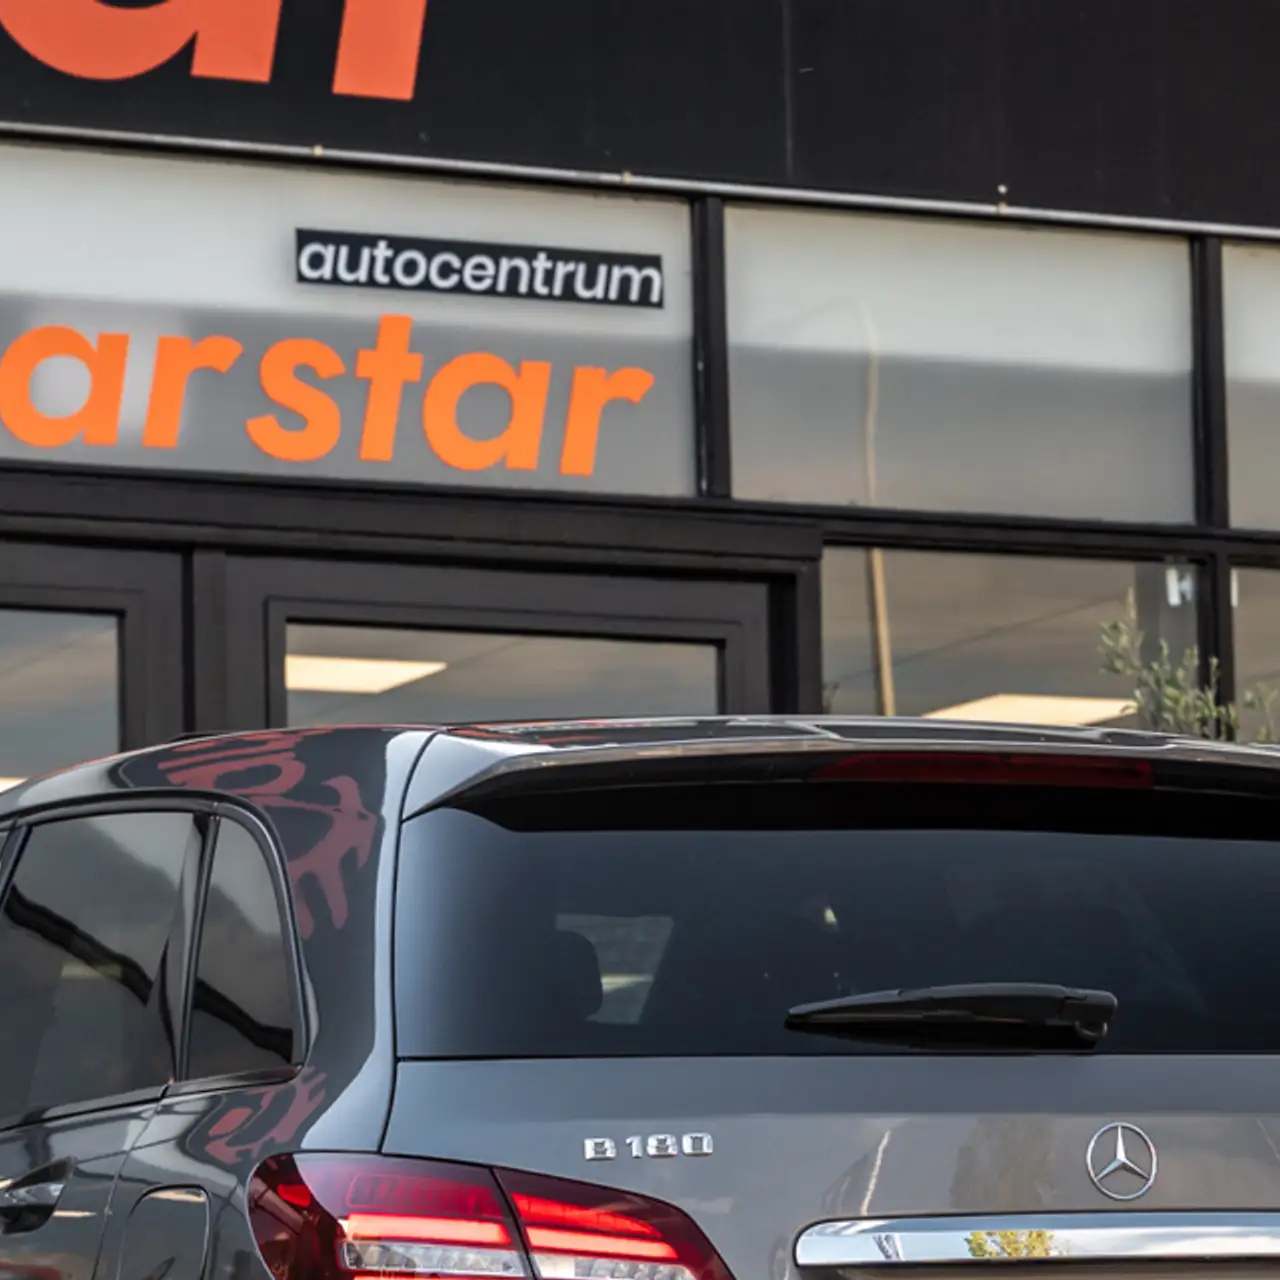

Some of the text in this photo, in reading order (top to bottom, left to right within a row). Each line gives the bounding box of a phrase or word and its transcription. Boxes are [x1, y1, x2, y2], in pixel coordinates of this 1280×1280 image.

[298, 240, 663, 304] autocentrum
[583, 1132, 714, 1162] B 180
